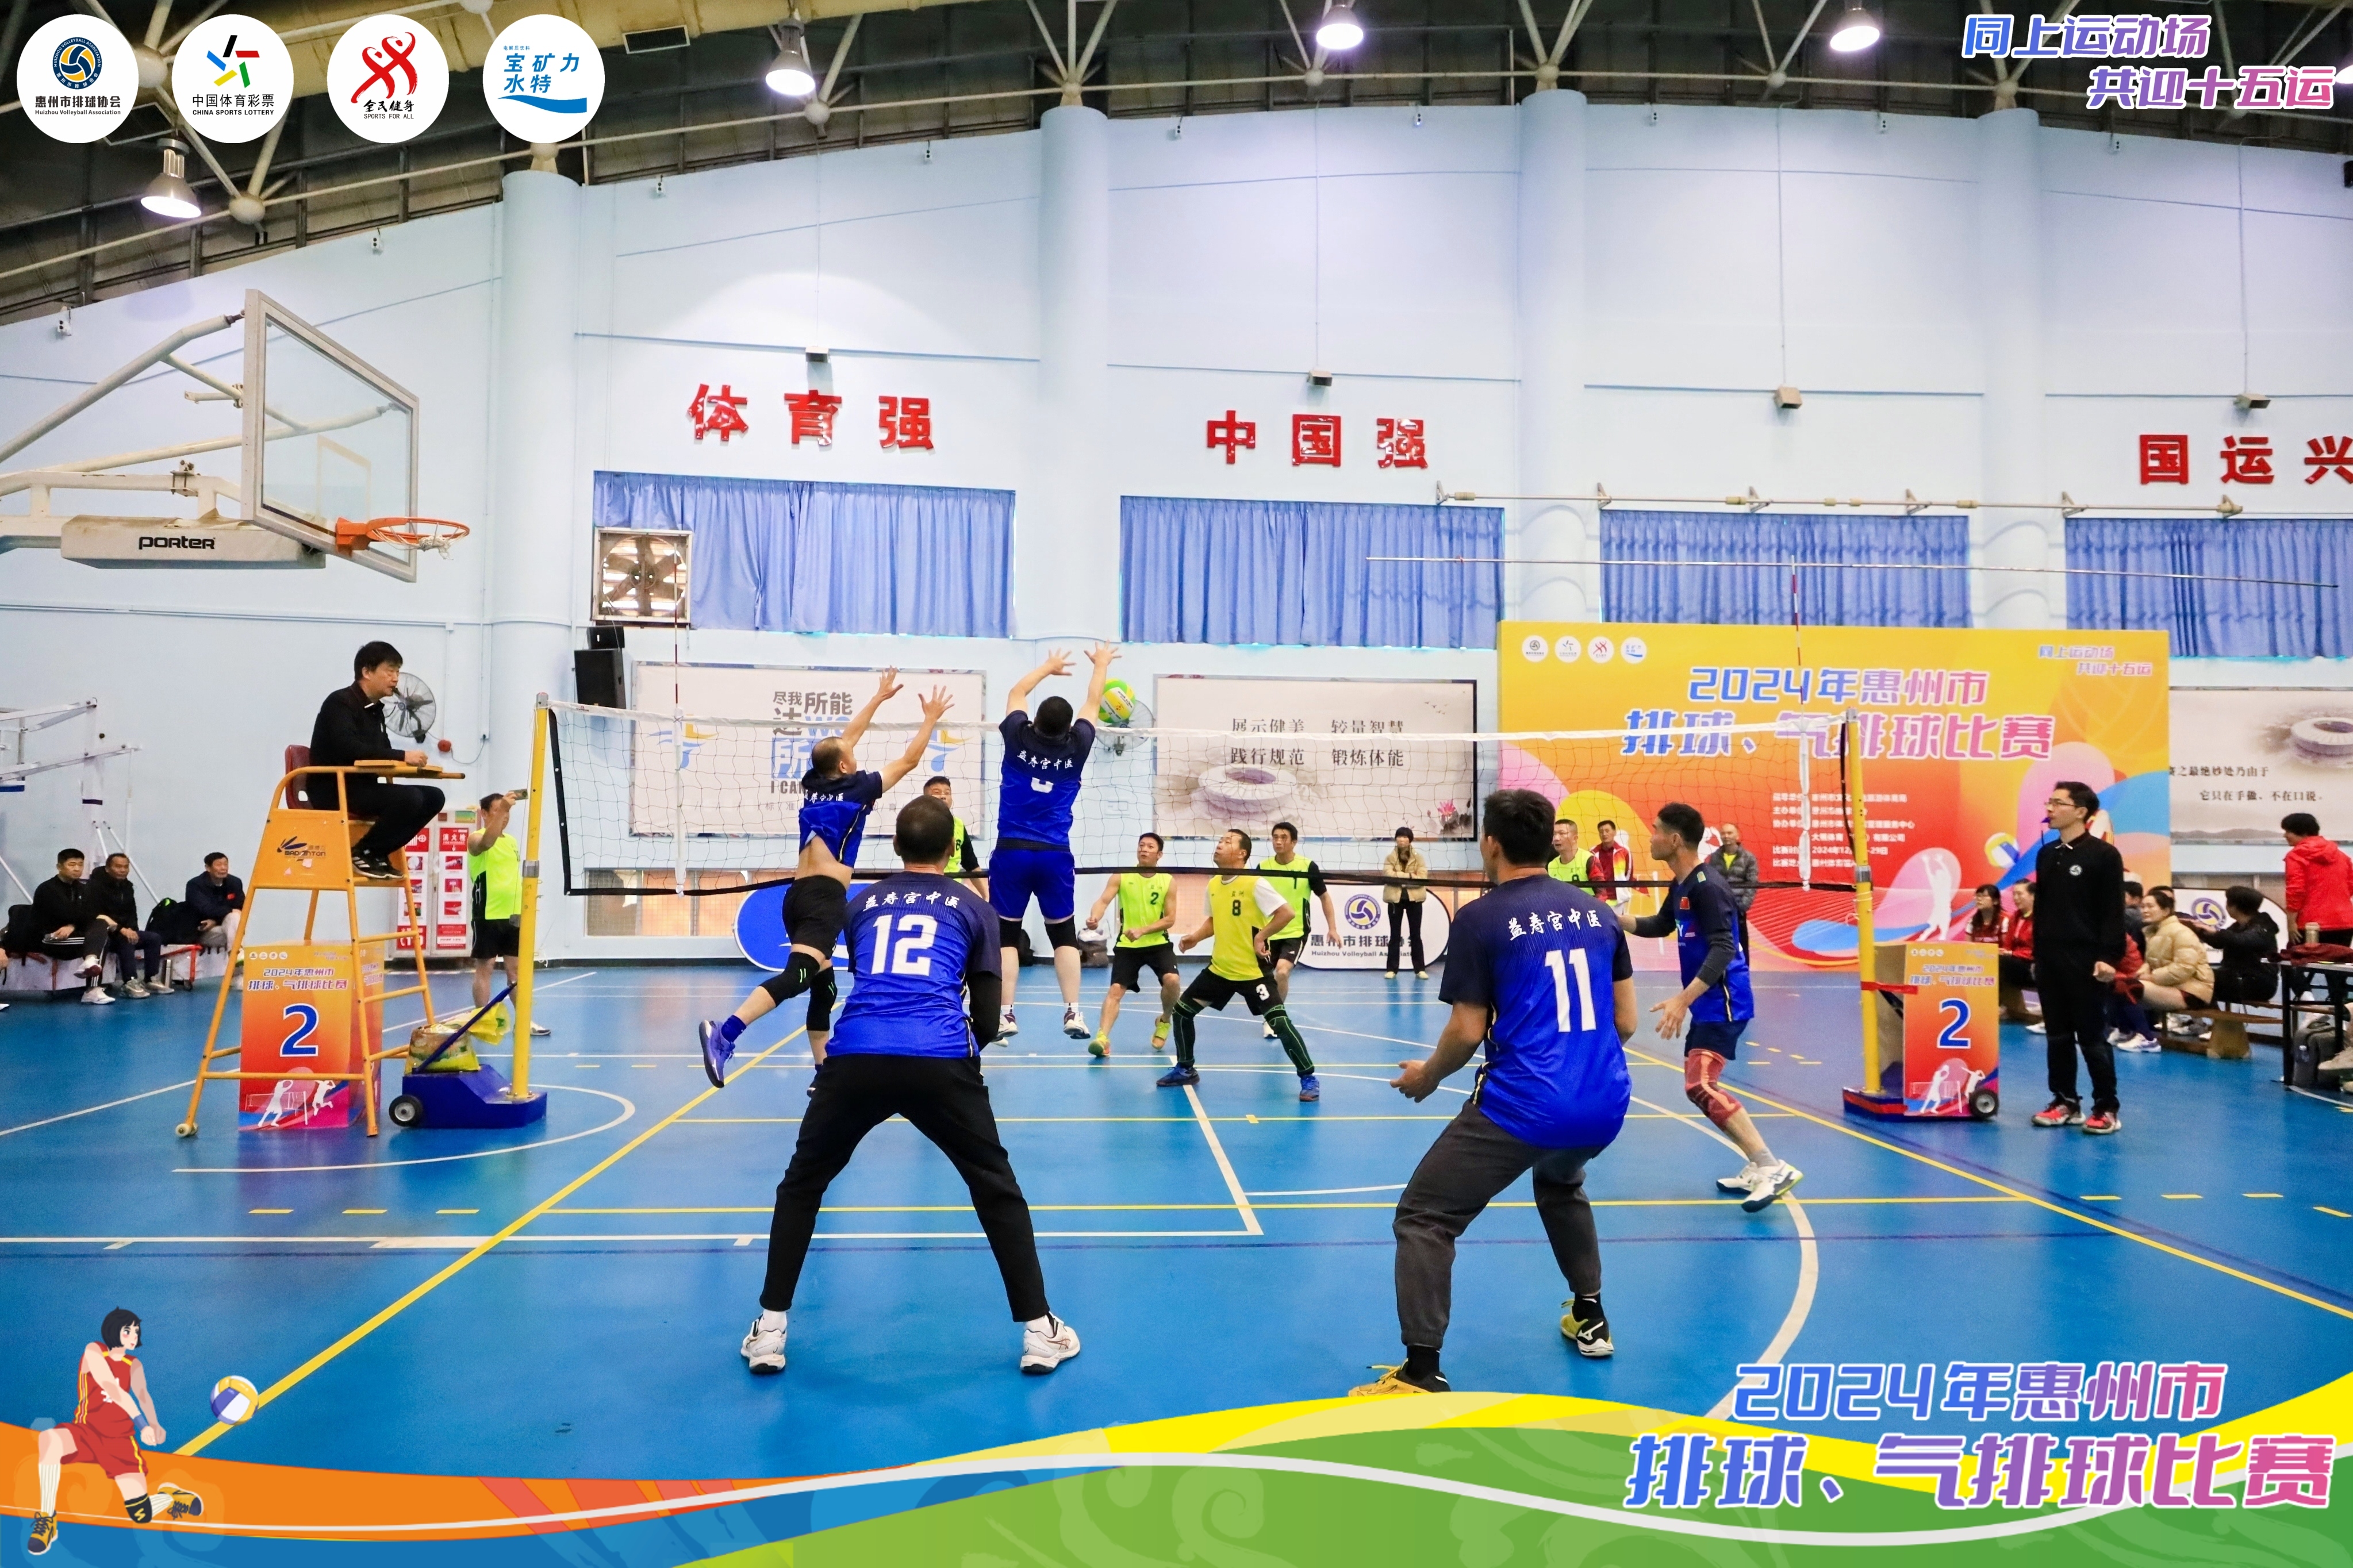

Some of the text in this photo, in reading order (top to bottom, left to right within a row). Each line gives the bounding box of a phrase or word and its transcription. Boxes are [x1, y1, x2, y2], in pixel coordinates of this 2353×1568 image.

[687, 384, 935, 449] 体育强
[1207, 410, 1429, 468] 中国强
[2139, 434, 2353, 485] 国运兴
[773, 691, 803, 706] 尽我
[1688, 666, 1990, 705] 2024年惠州市
[804, 692, 853, 716] 所能
[1232, 718, 1304, 733] 展示健美
[1231, 748, 1404, 767] 践行规范 锻炼体能
[862, 891, 960, 912] 益寿宫中医
[1150, 891, 1159, 905] 2
[1232, 899, 1241, 917] 8
[1508, 908, 1602, 941] 益寿宫中医
[871, 914, 938, 977] 12
[1256, 983, 1270, 1001] 3
[1544, 948, 1597, 1033] 11
[279, 1002, 320, 1058] 2
[1937, 997, 1971, 1049] 2
